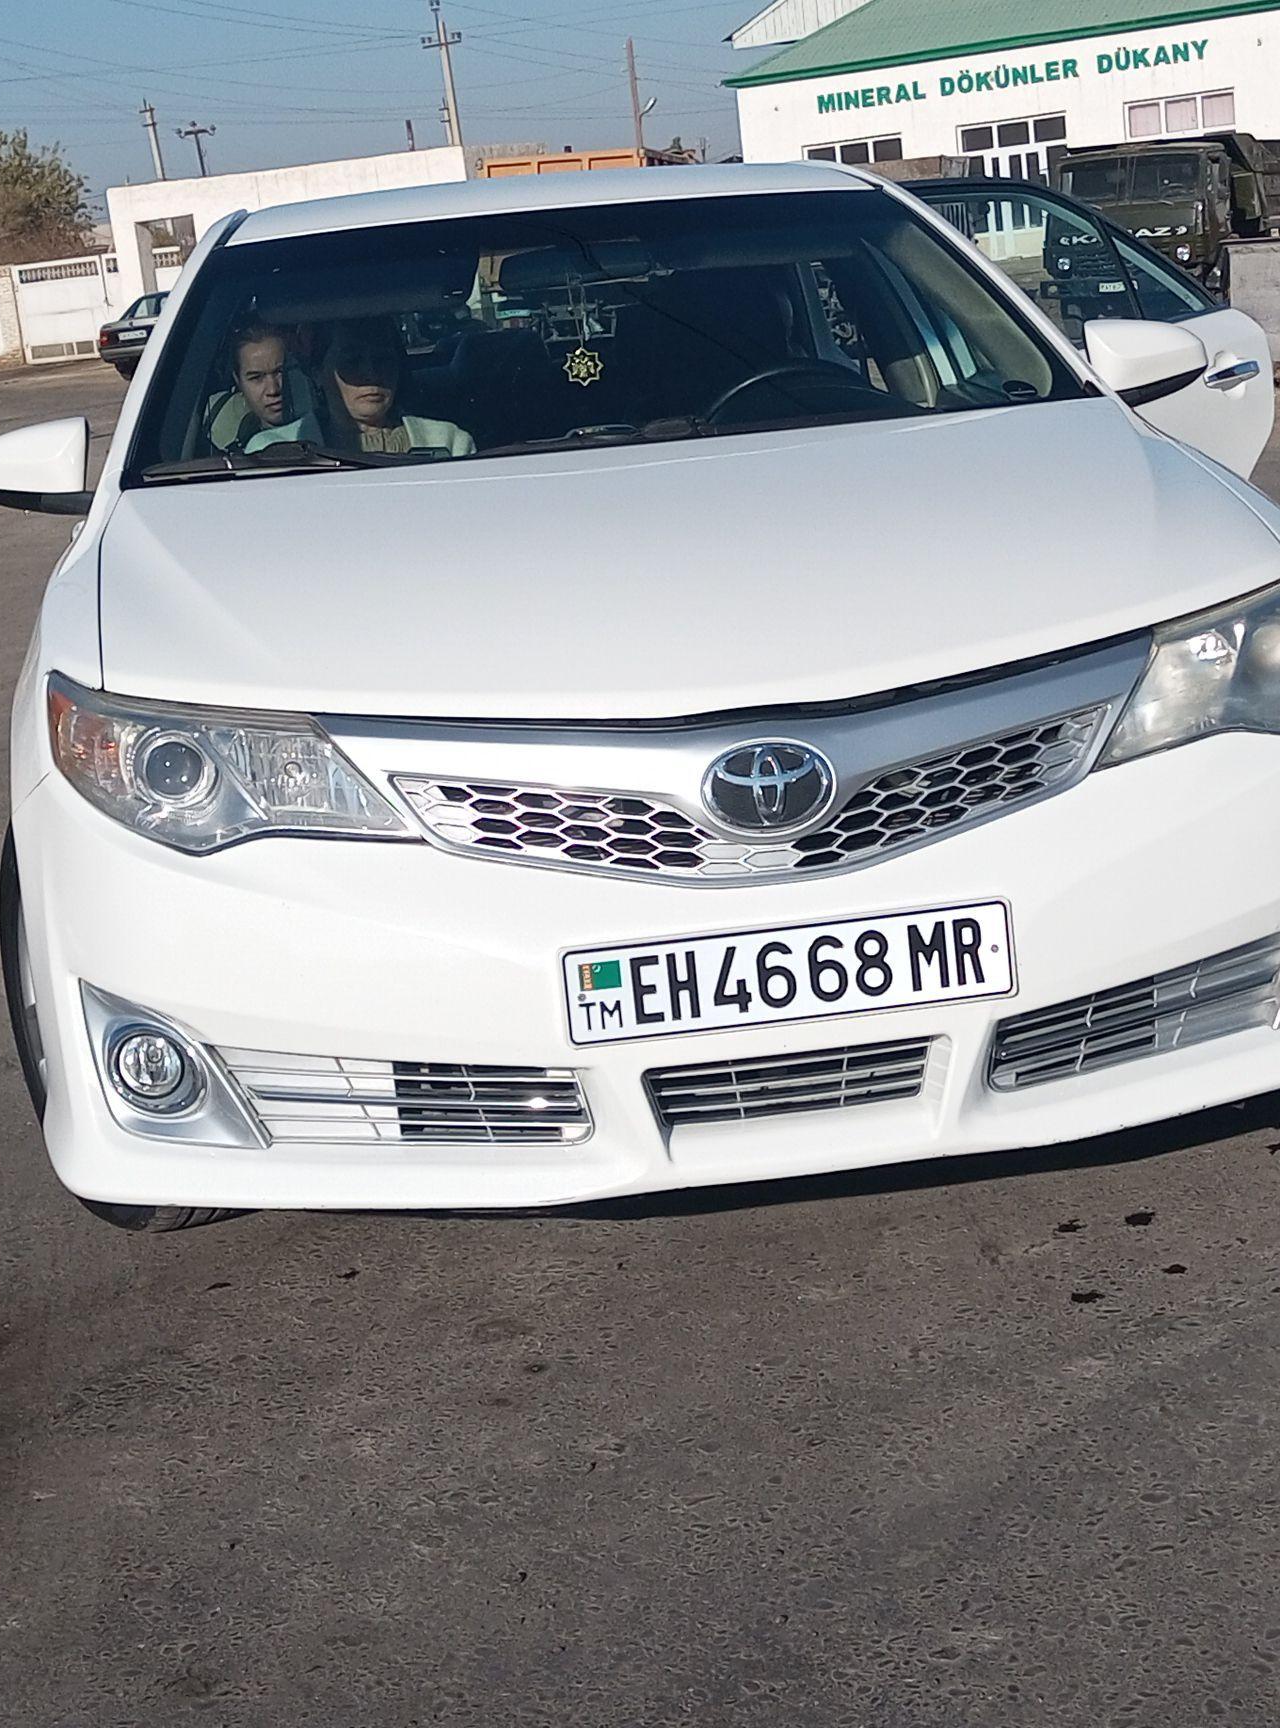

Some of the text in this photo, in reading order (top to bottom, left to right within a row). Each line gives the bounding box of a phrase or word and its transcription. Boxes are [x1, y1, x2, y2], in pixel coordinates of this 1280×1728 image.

[816, 39, 1209, 114] MINERAL DÖKÜNLER DÜKANY
[629, 917, 986, 1026] EH 4668 MR
[578, 1000, 624, 1032] TM
